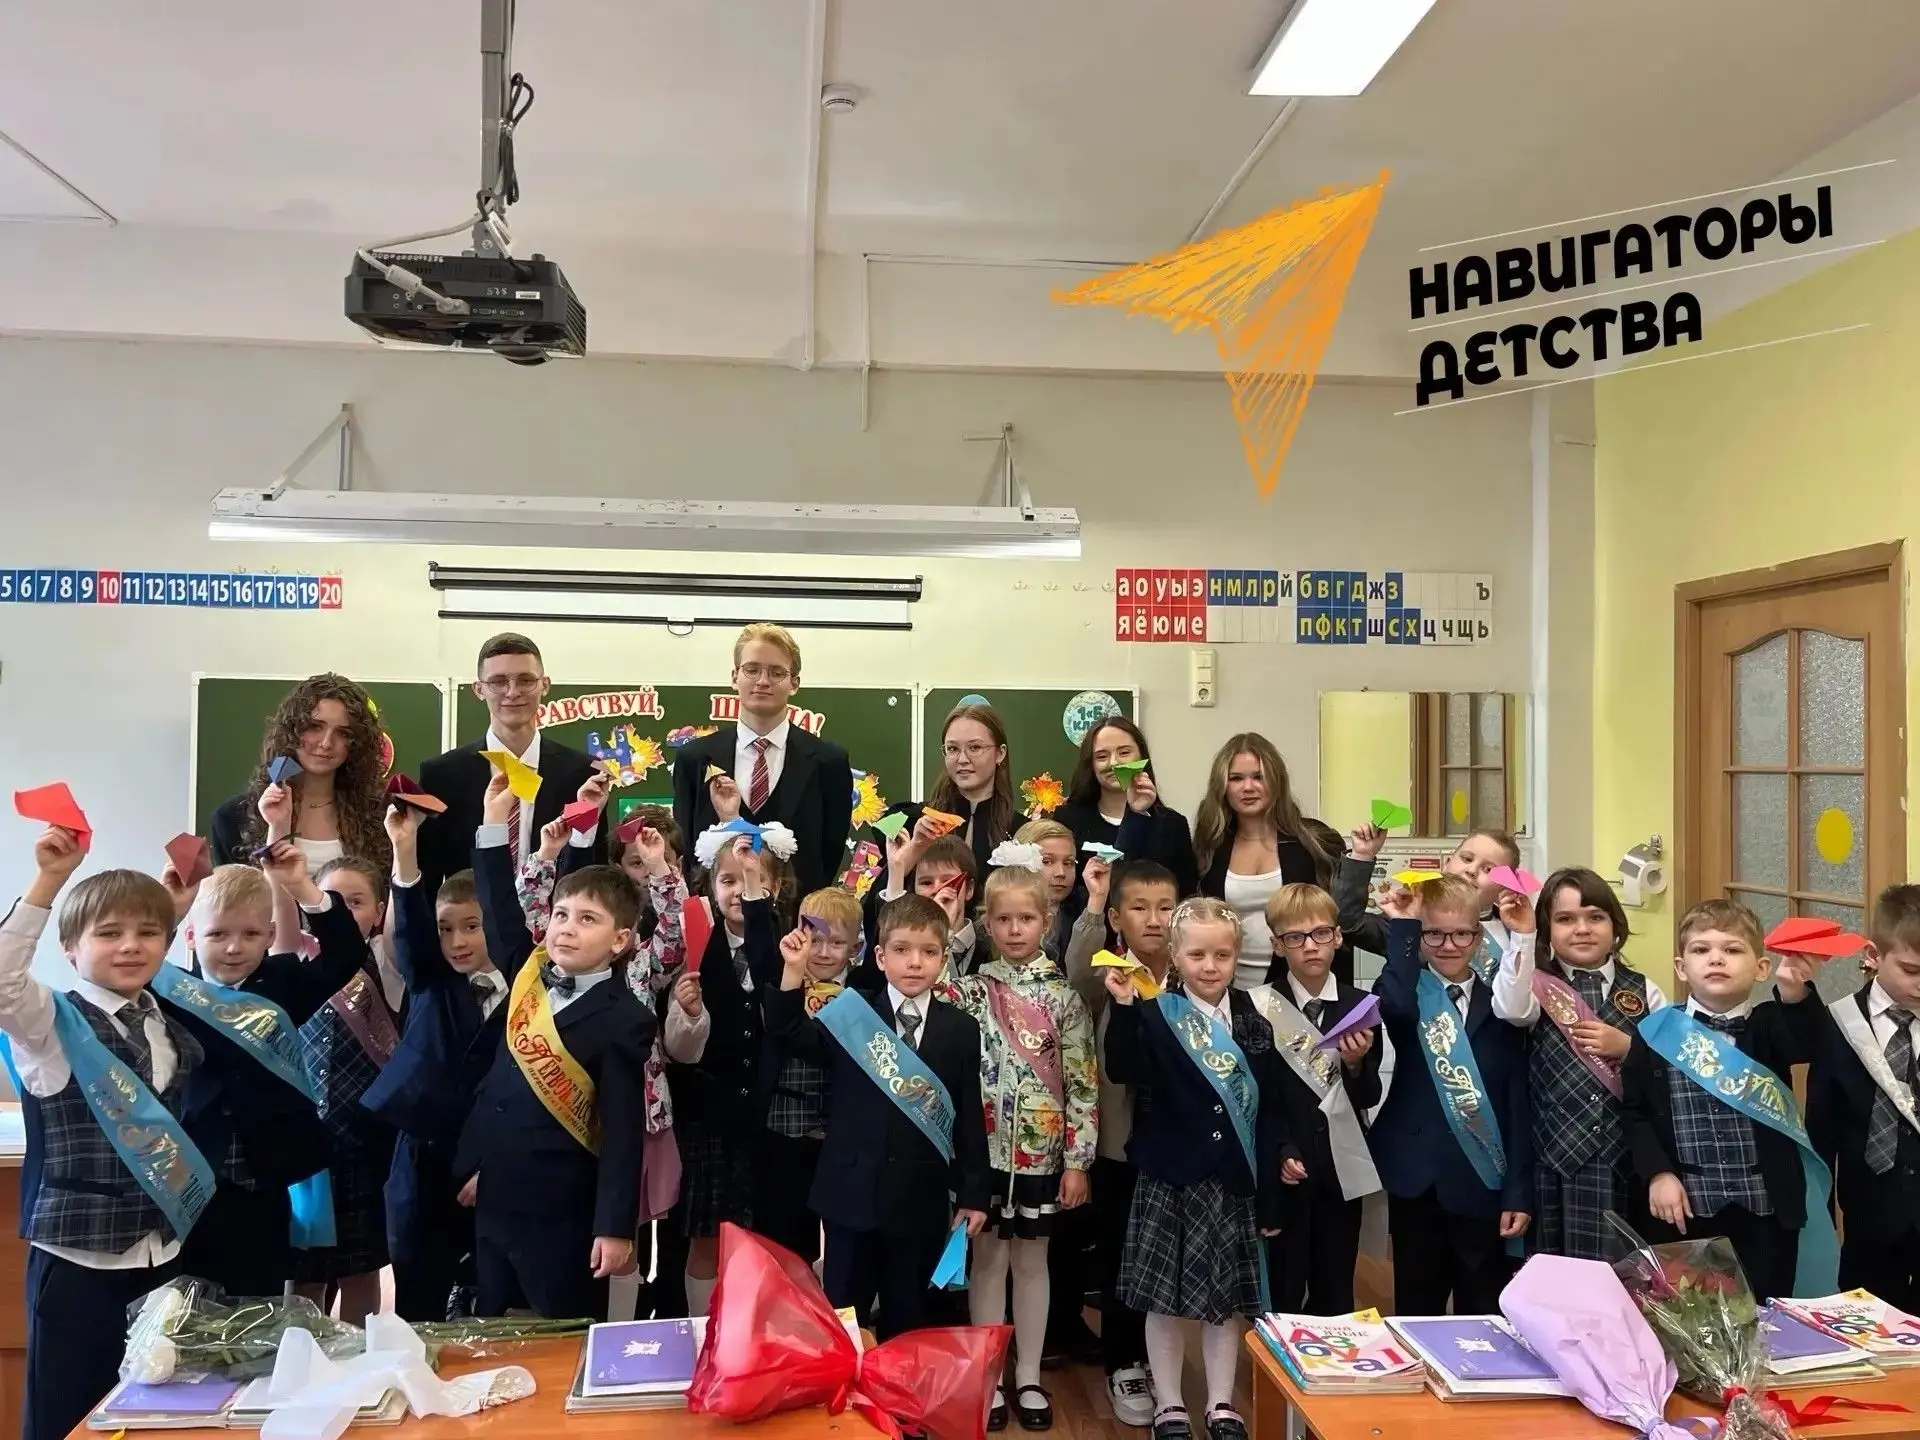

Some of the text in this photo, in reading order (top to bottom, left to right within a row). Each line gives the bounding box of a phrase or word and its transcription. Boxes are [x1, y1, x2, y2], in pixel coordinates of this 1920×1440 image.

[0, 575, 342, 606] 5 6 7 8 9 10 11 12 13 14 15 16 17 18 19 20
[535, 686, 663, 727] РАВСТВУЙ,
